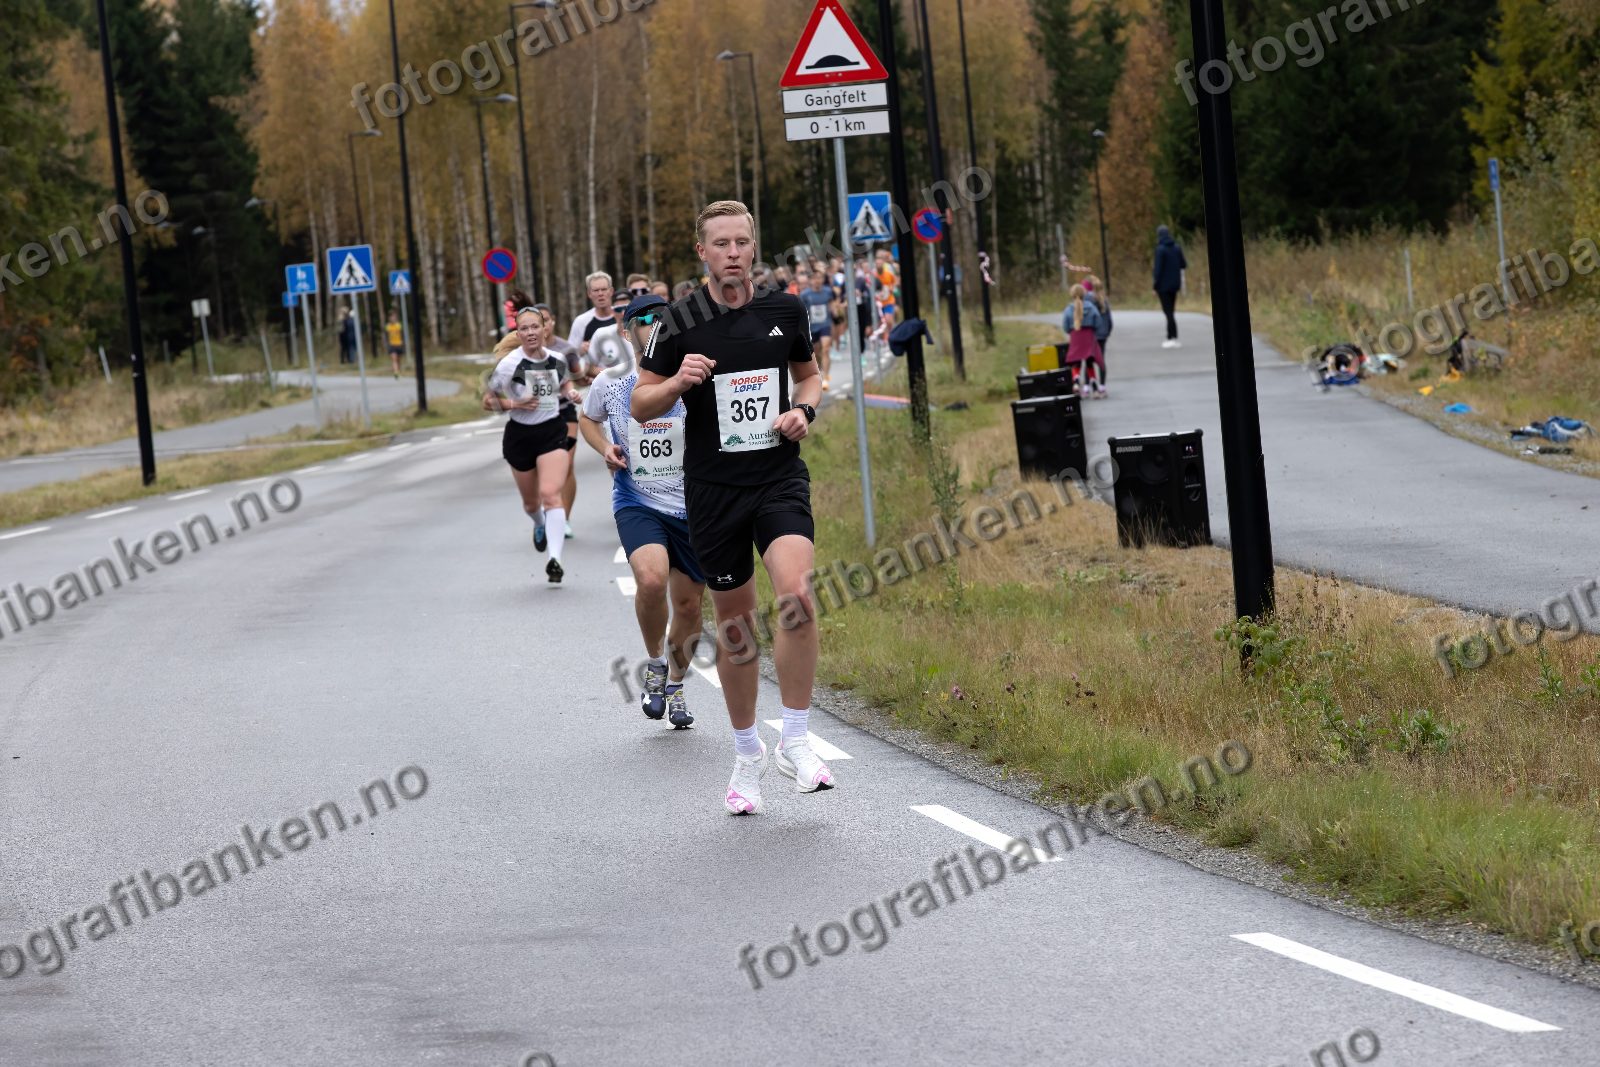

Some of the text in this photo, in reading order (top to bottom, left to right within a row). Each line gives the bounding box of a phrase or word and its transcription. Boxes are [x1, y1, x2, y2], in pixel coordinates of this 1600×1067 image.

[804, 90, 866, 107] Gangfelt
[810, 121, 819, 134] 0
[835, 120, 840, 132] 1
[845, 119, 866, 131] km
[730, 375, 769, 386] NORGES
[532, 384, 553, 396] 959
[731, 396, 769, 423] 367
[640, 439, 673, 458] 663
